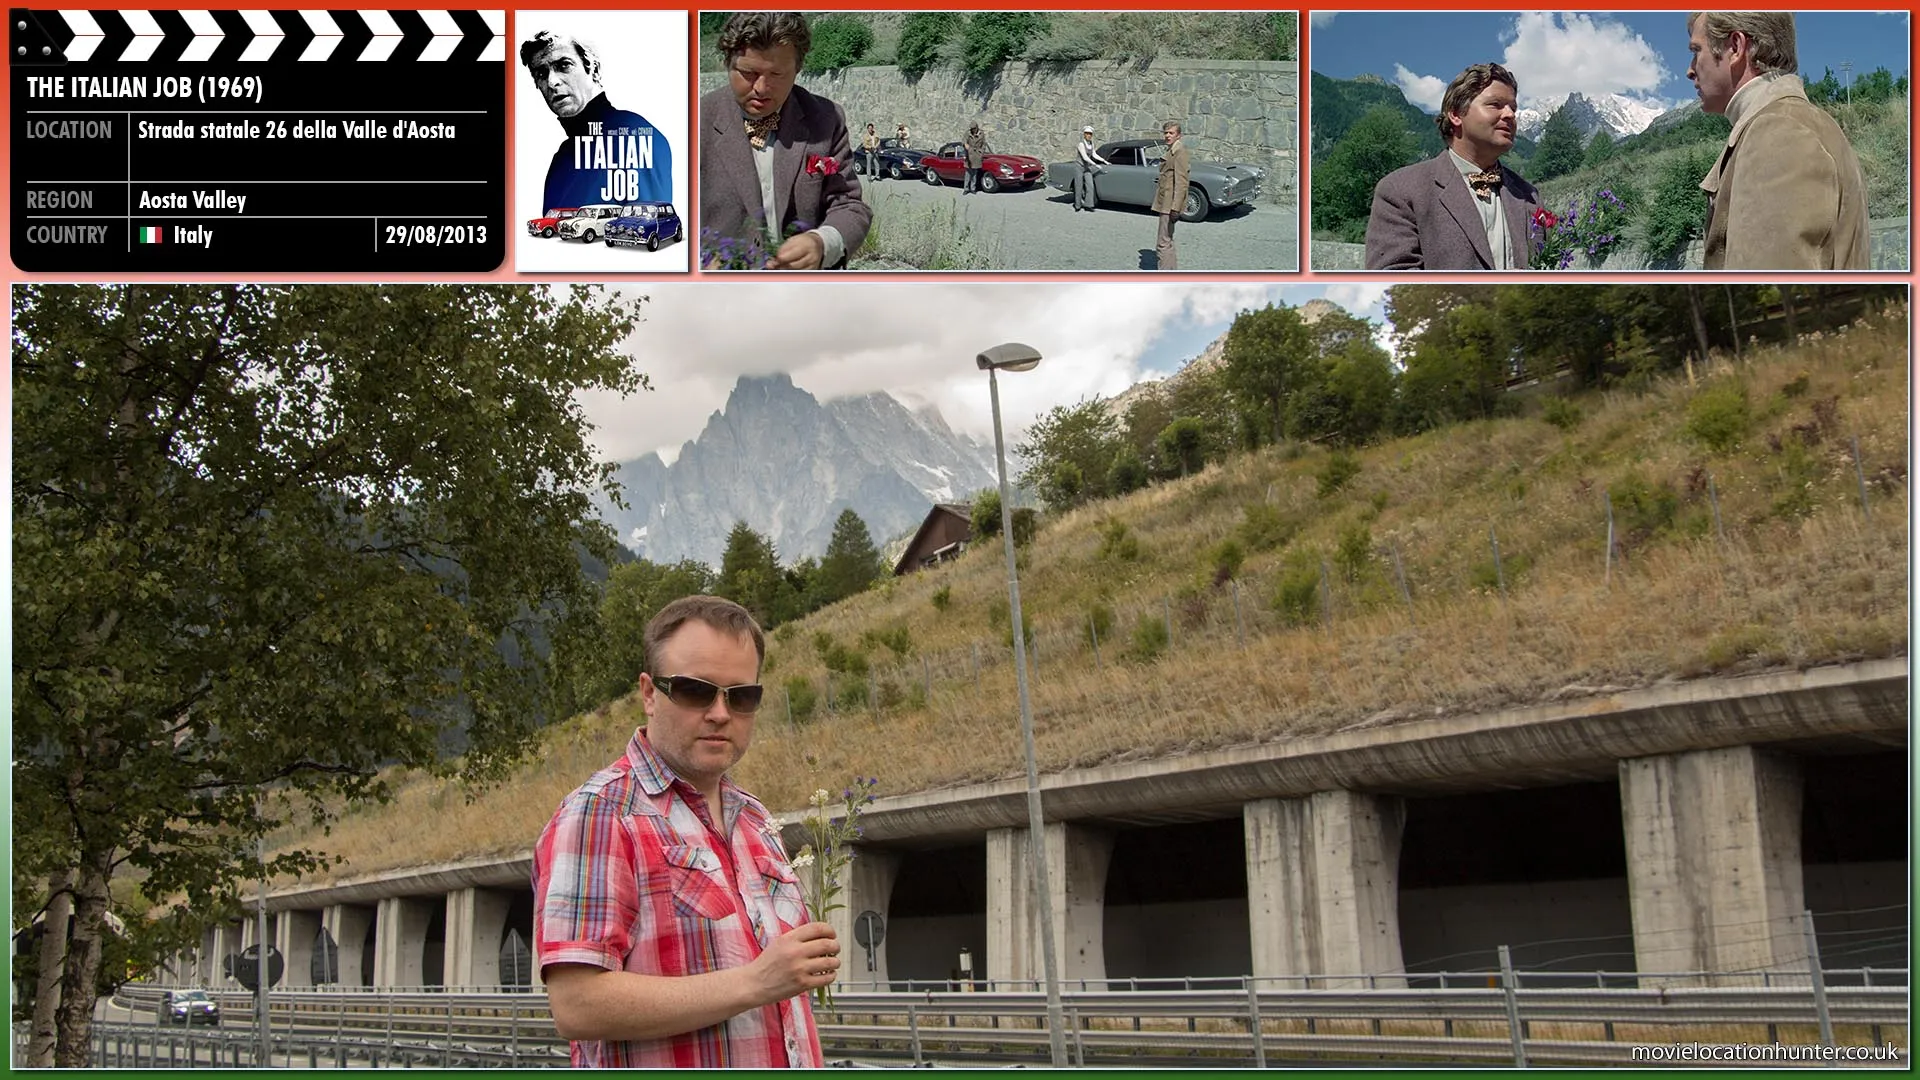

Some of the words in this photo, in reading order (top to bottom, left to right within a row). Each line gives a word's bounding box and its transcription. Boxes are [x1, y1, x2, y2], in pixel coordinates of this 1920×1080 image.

[588, 122, 603, 135] THE
[575, 136, 653, 169] ITALIAN
[601, 169, 639, 201] JOB
